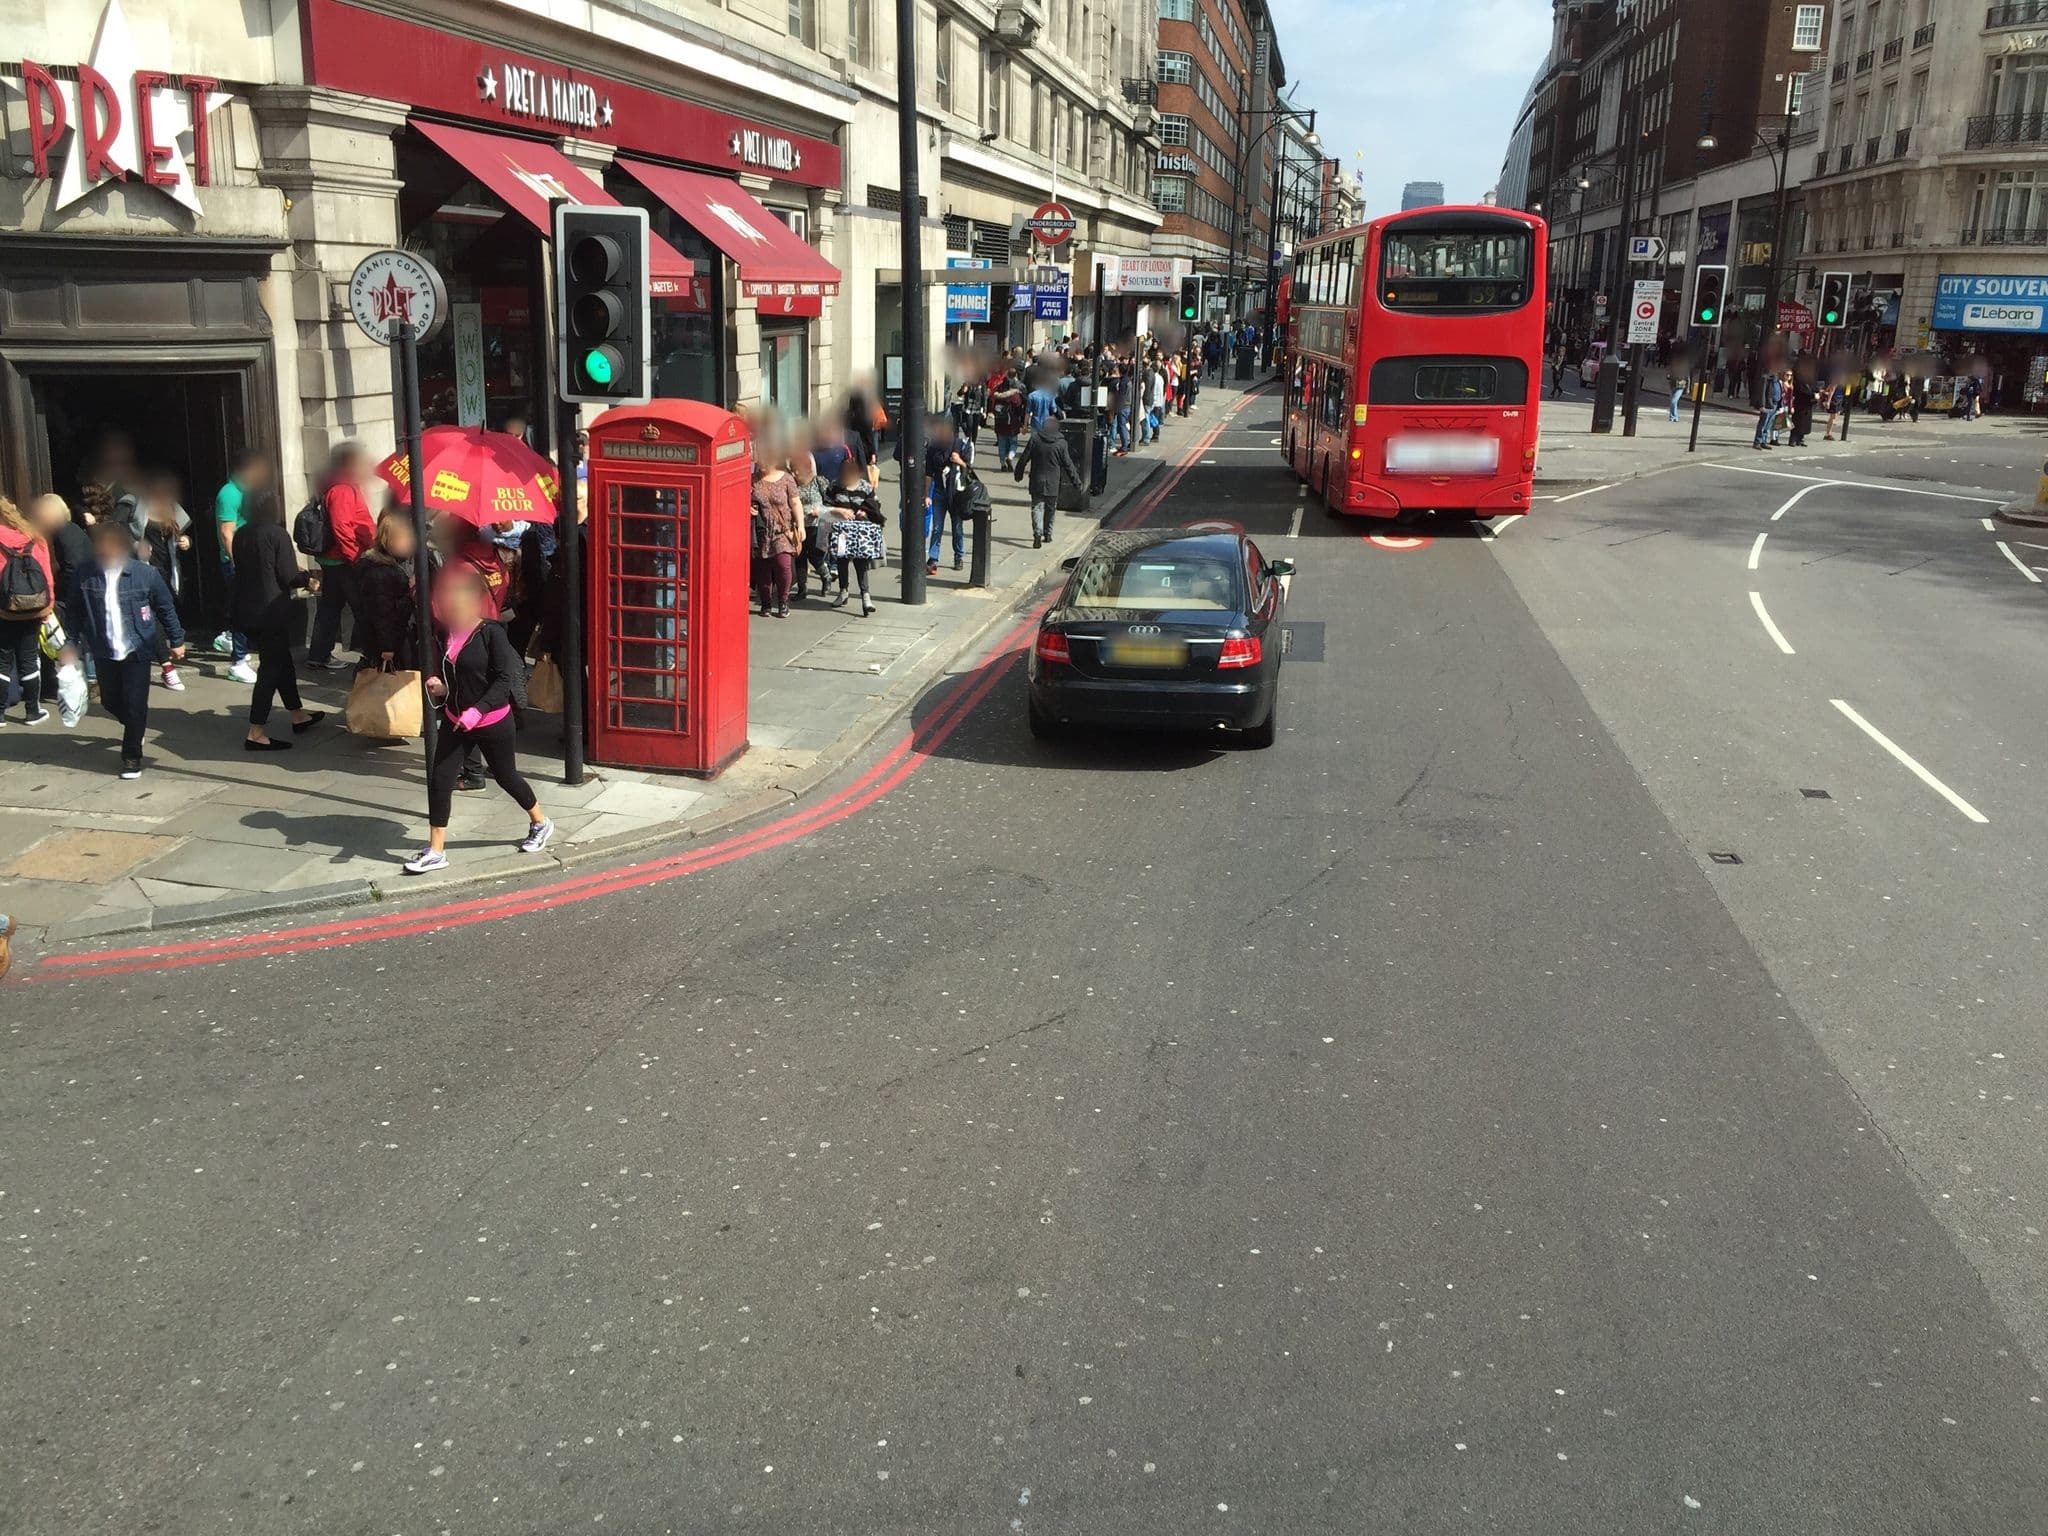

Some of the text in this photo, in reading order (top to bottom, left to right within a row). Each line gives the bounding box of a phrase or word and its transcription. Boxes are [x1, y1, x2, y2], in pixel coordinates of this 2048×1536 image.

[505, 64, 598, 128] PRET A MANGER
[22, 58, 219, 187] PRET
[744, 129, 793, 171] PRET A MANGER
[1157, 151, 1192, 171] histle
[1121, 260, 1140, 272] HEART
[1141, 261, 1148, 272] OF
[1149, 261, 1172, 273] LONDON
[355, 257, 430, 297] ORGANIC COFFEE
[1128, 277, 1162, 286] SOUVENIRS
[1036, 284, 1068, 293] MONEY
[1941, 279, 1973, 294] CITY
[372, 286, 413, 316] PRET
[947, 294, 986, 310] CHANGE
[1982, 306, 2034, 320] Lebara
[359, 312, 429, 340] NATUR OOD
[610, 442, 695, 462] TELEPHONE
[496, 487, 526, 499] BUS
[491, 499, 534, 511] TOUR
